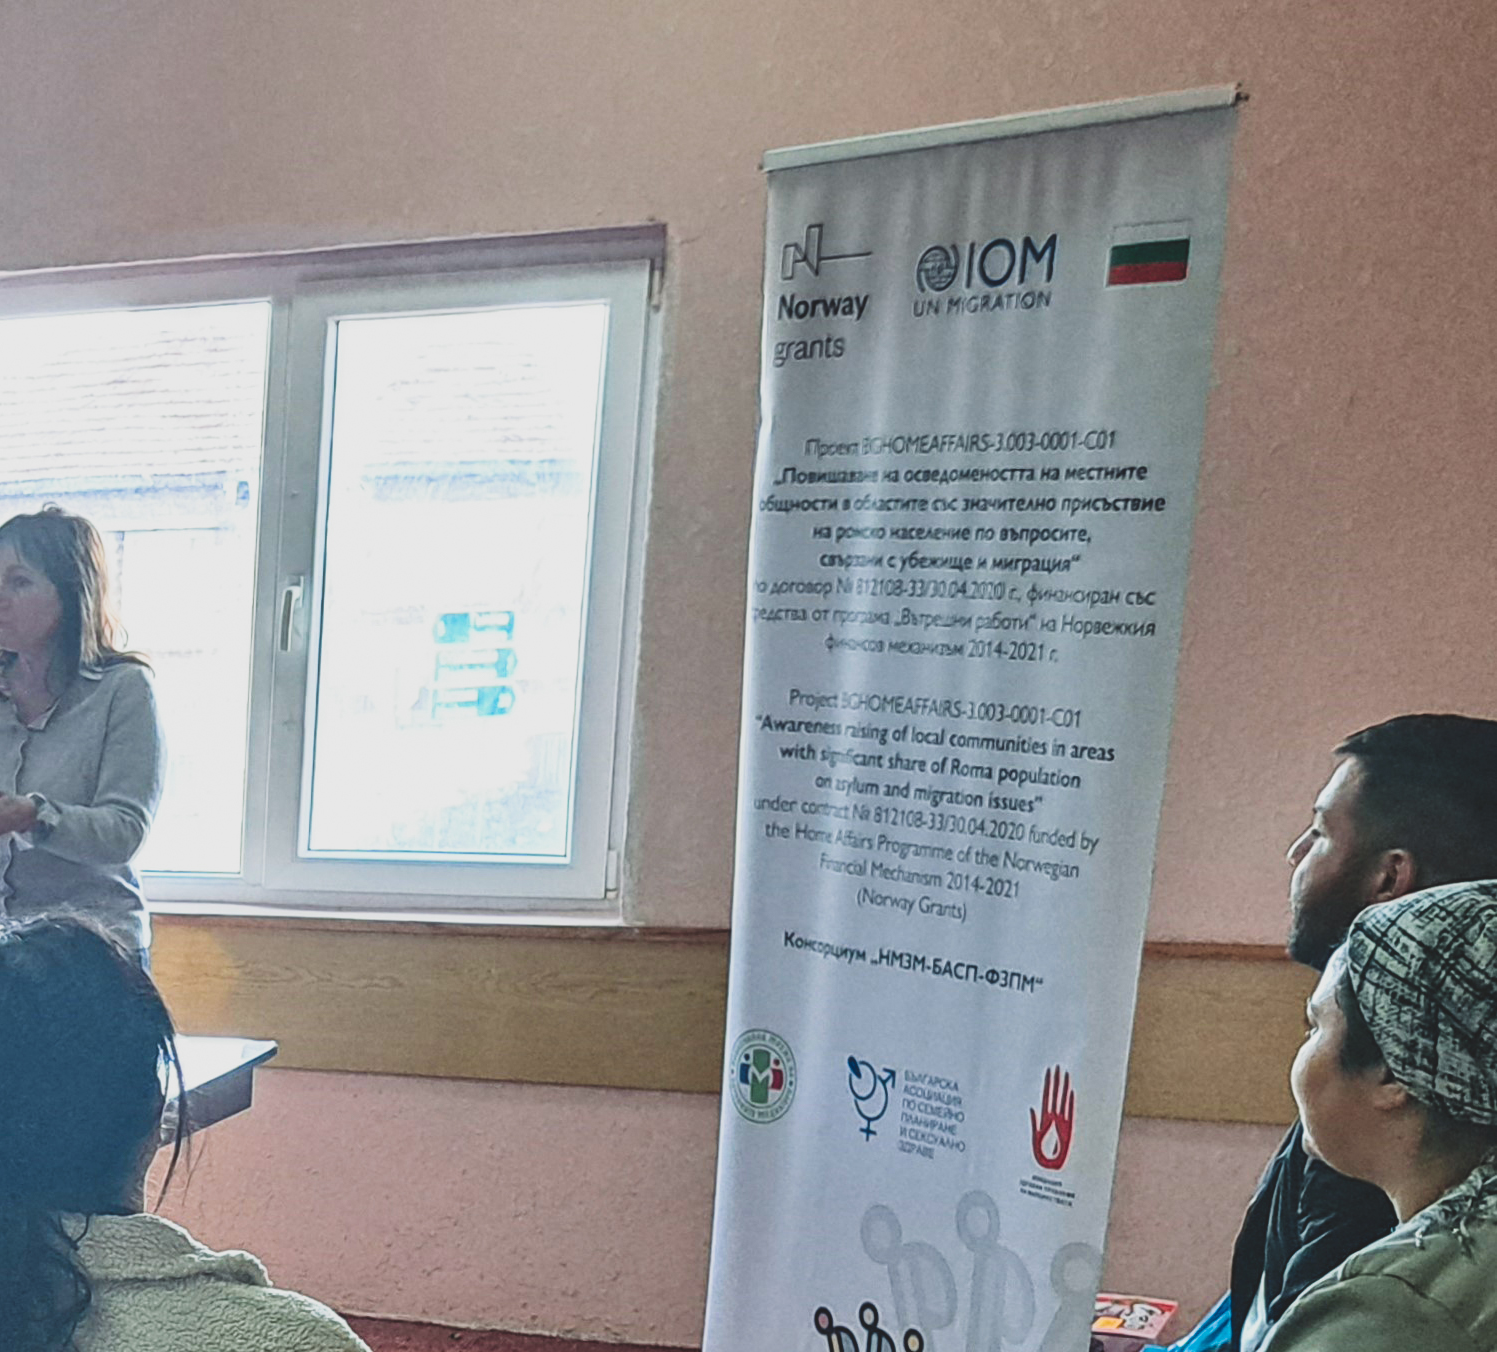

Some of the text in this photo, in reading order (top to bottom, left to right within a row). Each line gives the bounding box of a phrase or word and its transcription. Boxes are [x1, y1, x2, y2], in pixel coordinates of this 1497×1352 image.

[966, 233, 1057, 288] IOM
[778, 293, 869, 321] Norway
[913, 291, 1052, 317] UN MIGRATION
[773, 333, 845, 368] grants
[804, 438, 858, 460] Проект
[773, 466, 1148, 485] „Повишаване на осведомеността на местните
[759, 494, 1166, 517] общности в областите със значително присъствие
[813, 526, 831, 540] на
[890, 527, 969, 541] население
[975, 527, 994, 541] по
[999, 527, 1091, 547] въпросите,
[886, 555, 895, 568] с
[899, 551, 972, 572] убежище
[977, 557, 986, 570] и
[991, 554, 1080, 576] миграция“
[769, 580, 832, 599] договор
[1026, 583, 1119, 609] финансиран
[1125, 591, 1156, 606] със
[812, 608, 829, 622] от
[974, 611, 1036, 633] работи“
[1040, 618, 1056, 631] на
[1060, 615, 1156, 639] Норвежкия
[967, 639, 1044, 661] 2014-2021
[1048, 647, 1058, 662] г.
[789, 688, 837, 711] Project
[755, 714, 1115, 762] “Awareness raising of local communities in areas
[780, 744, 1081, 789] with significant share of Roma population
[815, 774, 832, 789] on
[835, 776, 879, 796] asylum
[883, 781, 910, 799] and
[913, 786, 983, 808] migration
[754, 795, 797, 812] under
[801, 801, 849, 820] contract
[874, 806, 1025, 841] 812108-33/30.04.2020
[1029, 824, 1076, 849] funded
[1080, 829, 1099, 855] by
[765, 821, 1080, 881] the Home Affairs Programme of the Norwegian
[819, 852, 1019, 899] Financial Mechanism 2014-2021
[856, 887, 967, 924] (Norway Grants)
[784, 931, 866, 964] Консорциум
[903, 1085, 962, 1107] АСОЦИАЦИЯ
[901, 1112, 957, 1136] ПЛАНИРАНЕ
[902, 1098, 965, 1123] ПО СЕМЕЙНО
[900, 1126, 966, 1153] И СЕКСУАЛНО
